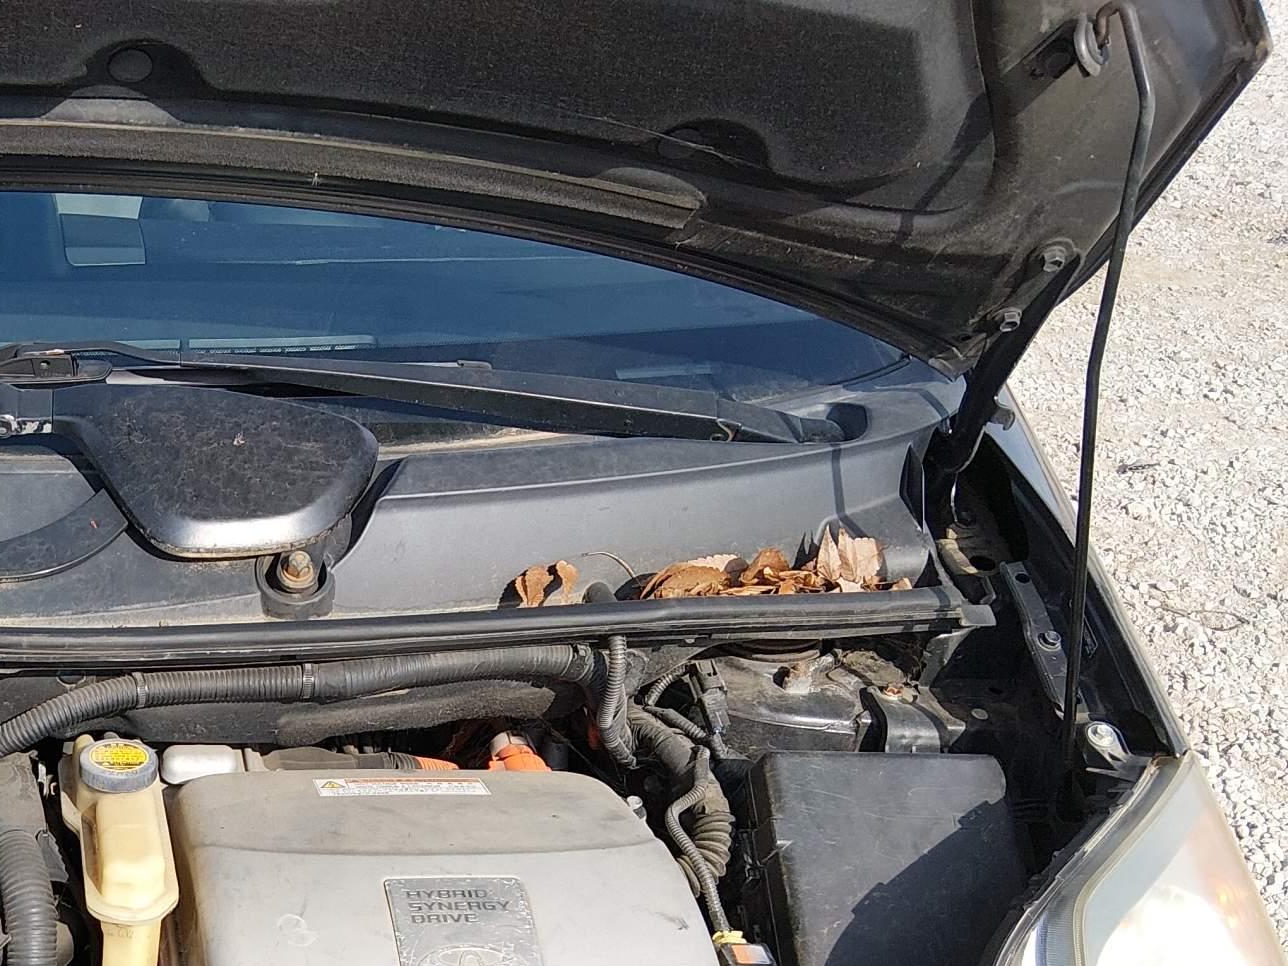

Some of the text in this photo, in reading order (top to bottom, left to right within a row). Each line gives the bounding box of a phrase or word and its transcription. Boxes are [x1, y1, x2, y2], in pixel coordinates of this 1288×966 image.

[404, 889, 488, 899] HYBRID
[408, 901, 510, 912] SYNERGY
[412, 913, 480, 924] DRIVE
